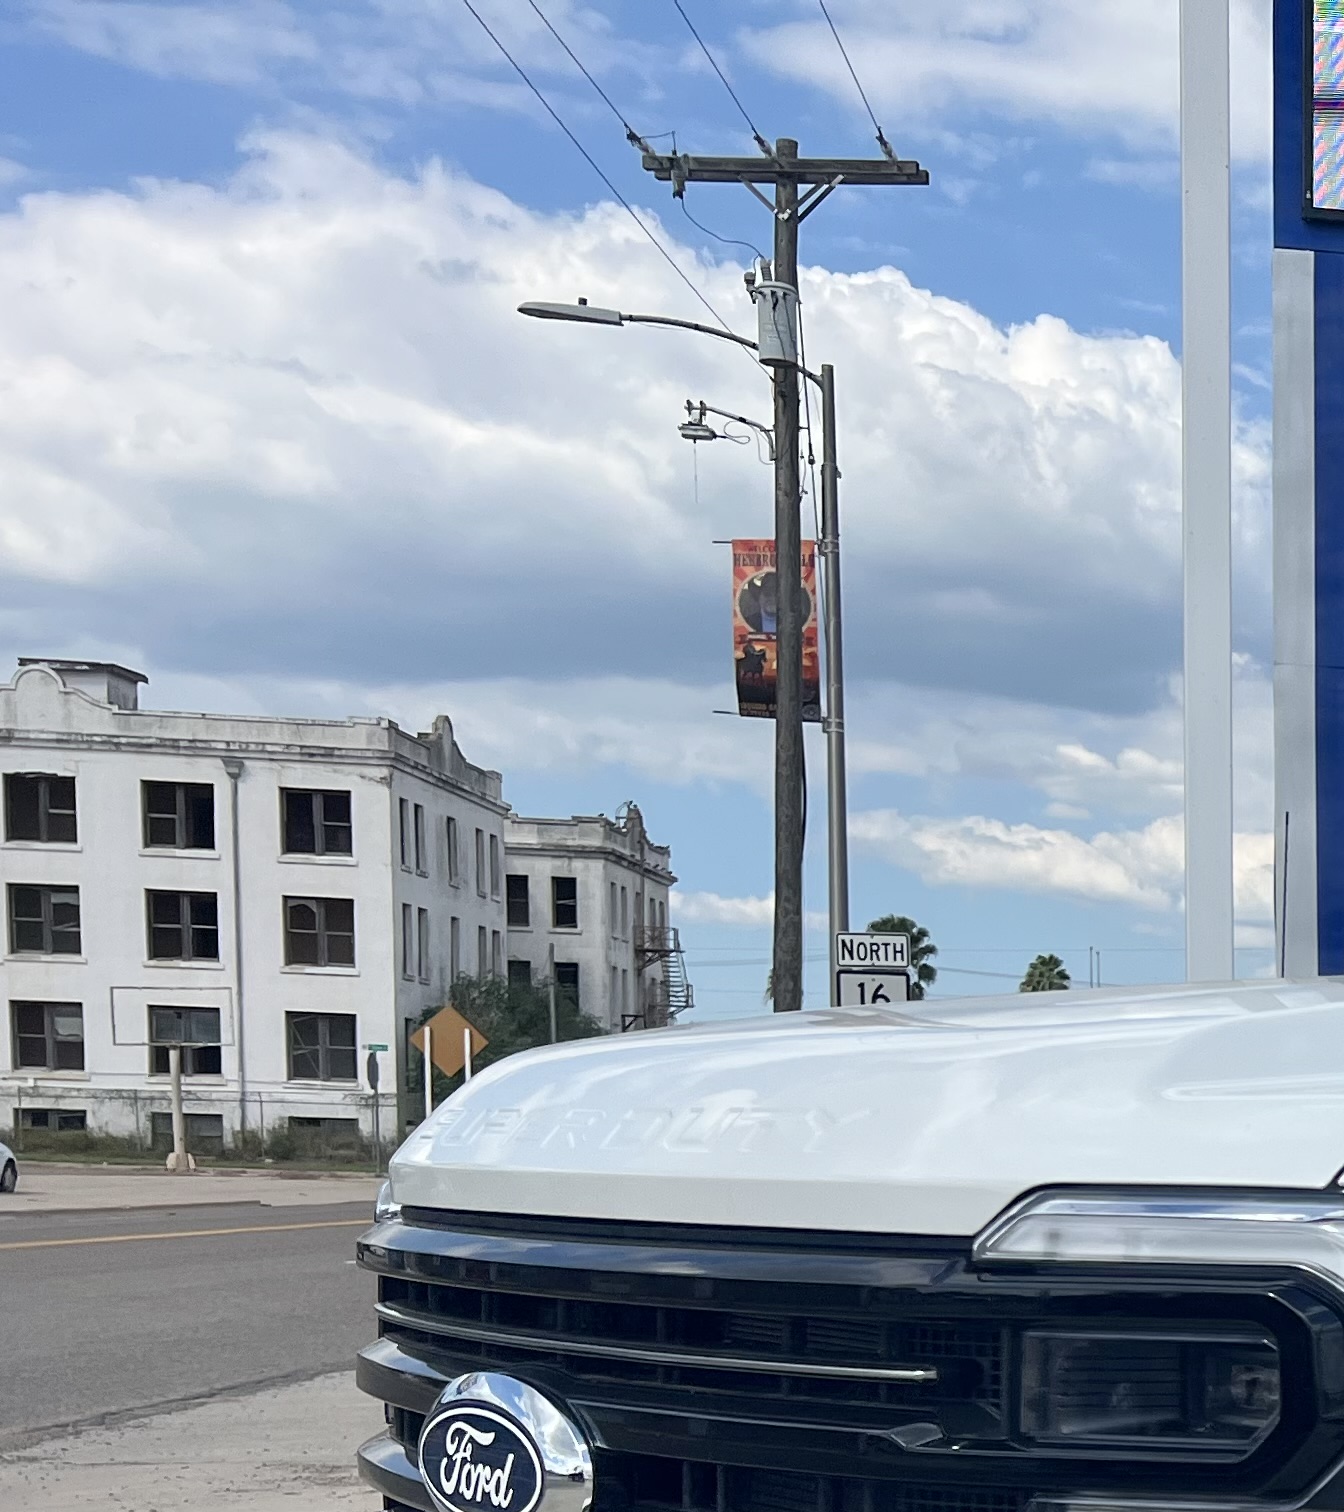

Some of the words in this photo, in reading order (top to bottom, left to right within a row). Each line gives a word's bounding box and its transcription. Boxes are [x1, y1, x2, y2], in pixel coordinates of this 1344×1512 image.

[841, 938, 905, 961] NORTH
[857, 982, 891, 1005] 16
[440, 1421, 515, 1509] Ford
